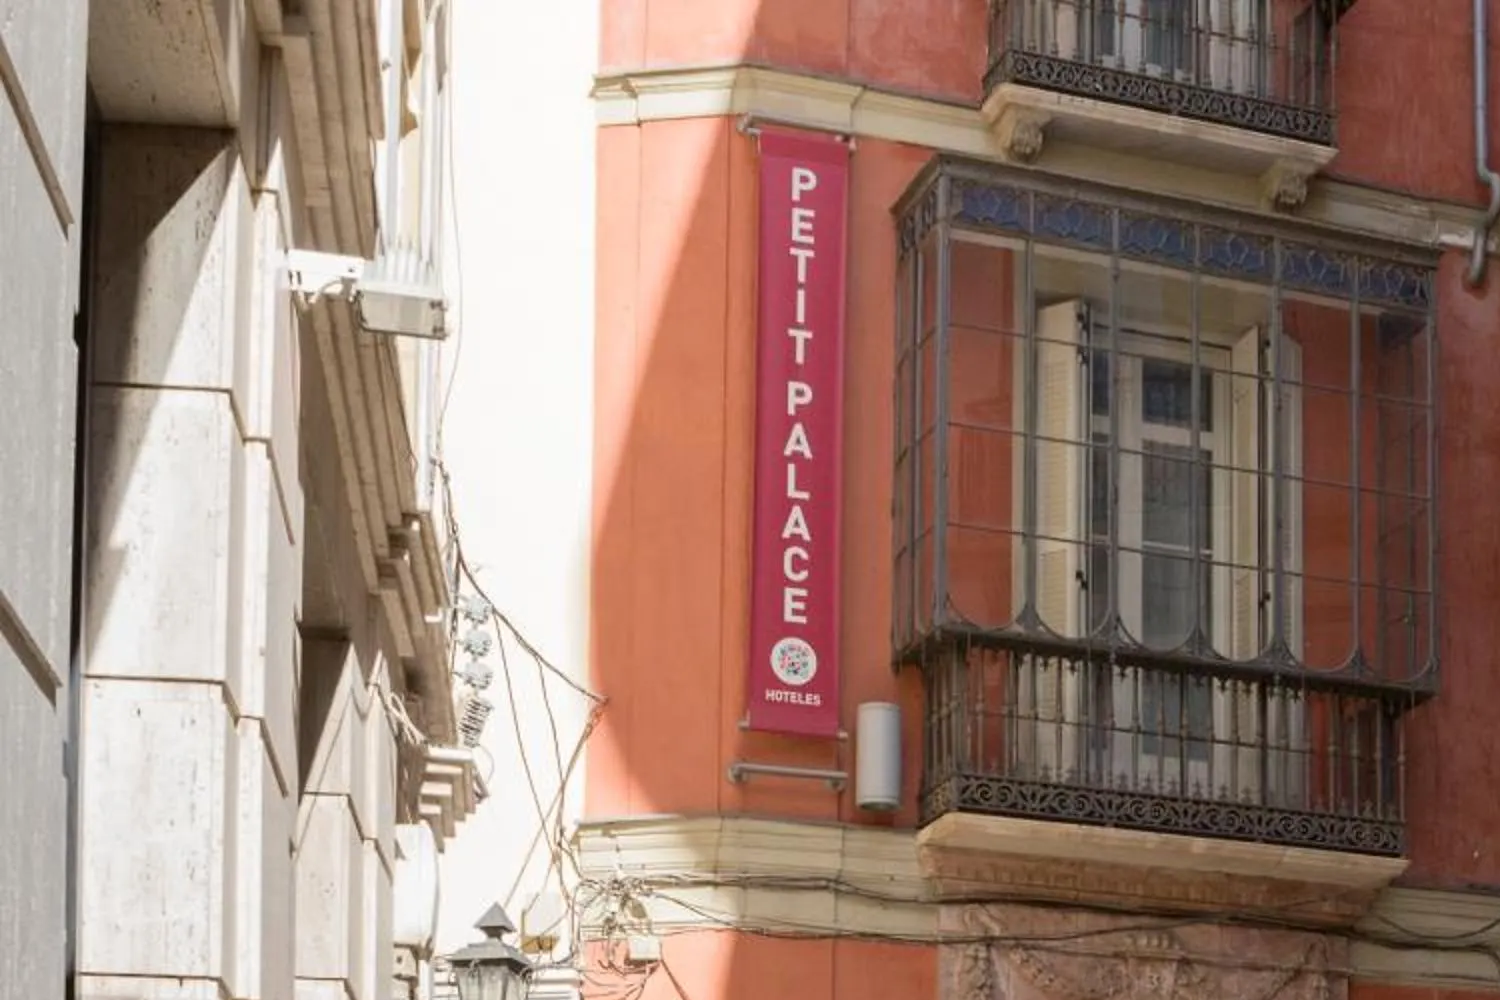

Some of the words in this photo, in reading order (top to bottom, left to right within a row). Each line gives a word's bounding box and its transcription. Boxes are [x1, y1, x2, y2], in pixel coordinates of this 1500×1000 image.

[788, 167, 817, 364] PETIT
[782, 381, 813, 624] PALACE
[765, 688, 821, 706] HOTELES
